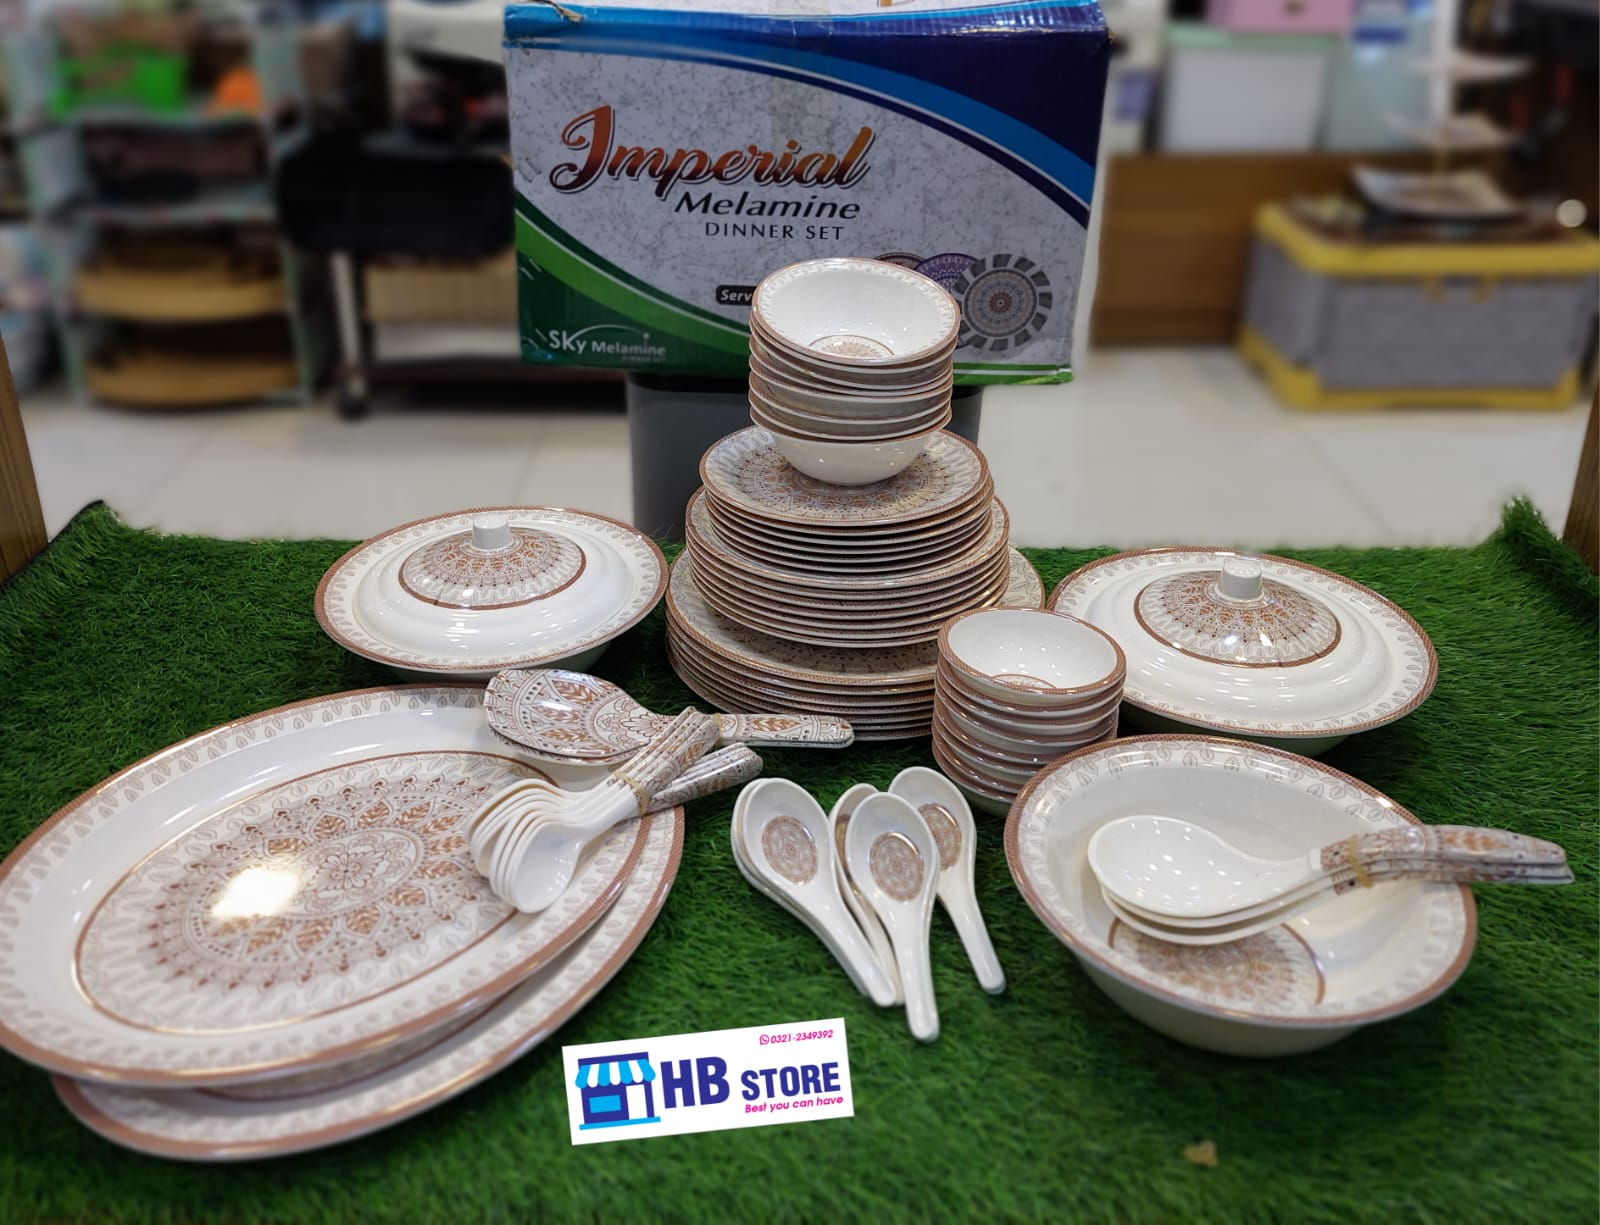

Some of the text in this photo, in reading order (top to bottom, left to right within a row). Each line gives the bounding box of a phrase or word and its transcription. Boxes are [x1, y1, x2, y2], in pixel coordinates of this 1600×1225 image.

[549, 104, 875, 201] Imperial
[674, 191, 860, 220] Melamine
[705, 222, 844, 240] DINNER SET
[721, 289, 753, 302] Serv
[591, 333, 666, 355] Melamine
